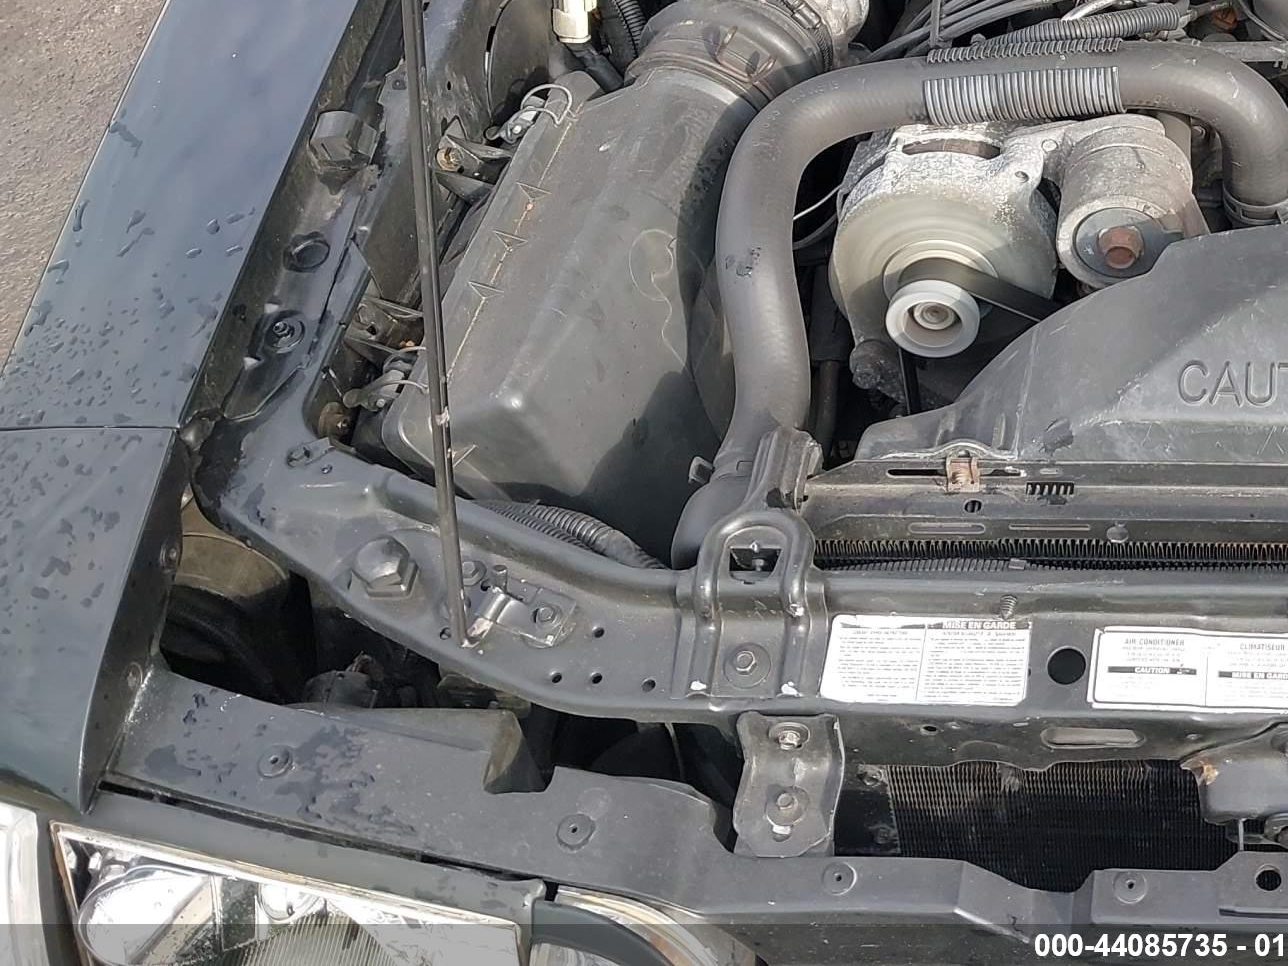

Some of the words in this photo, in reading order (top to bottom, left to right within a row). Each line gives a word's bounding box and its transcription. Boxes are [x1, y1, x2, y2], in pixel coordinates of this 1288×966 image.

[943, 621, 967, 629] MISE
[968, 621, 981, 629] EN
[983, 621, 1017, 630] GARDE
[1138, 638, 1185, 646] CONDITIONER
[1239, 642, 1286, 651] CLIMATISEUR
[1134, 666, 1171, 674] CAUTION
